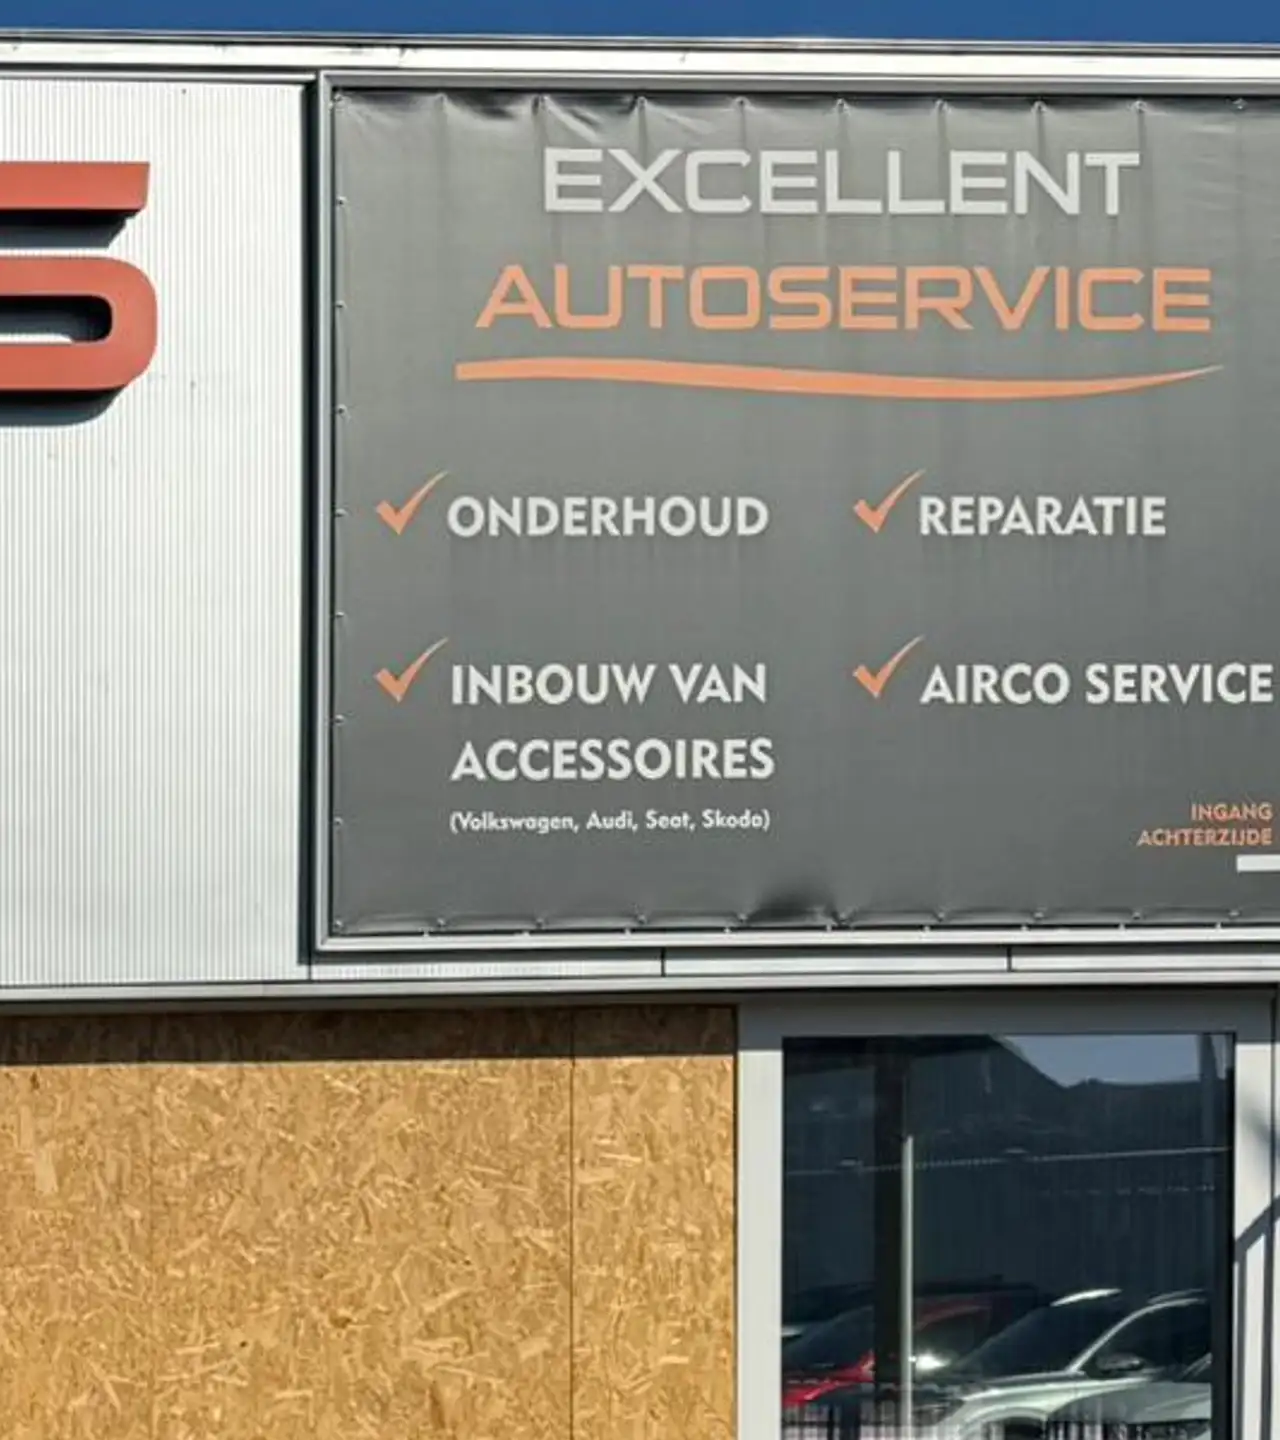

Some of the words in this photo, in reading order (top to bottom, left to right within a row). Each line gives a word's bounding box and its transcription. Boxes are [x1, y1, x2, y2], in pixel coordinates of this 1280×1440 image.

[543, 147, 1141, 215] EXCELLENT
[474, 264, 1212, 331] AUTOSERVICE
[447, 496, 770, 537] ONDERHOUD
[919, 496, 1166, 536] REPARATIE
[451, 663, 656, 706] INBOUW
[668, 663, 767, 703] VAN
[920, 663, 1070, 705] AIRCO
[1085, 663, 1273, 704] SERVICE
[450, 737, 776, 781] ACCESSOIRES
[449, 811, 579, 834] (Volkswagen,
[586, 810, 638, 831] Audi,
[646, 809, 696, 830] Seat,
[702, 808, 771, 830] Skoda)
[1190, 803, 1273, 821] INGANG
[1136, 828, 1273, 846] ACHTERZIJDE
